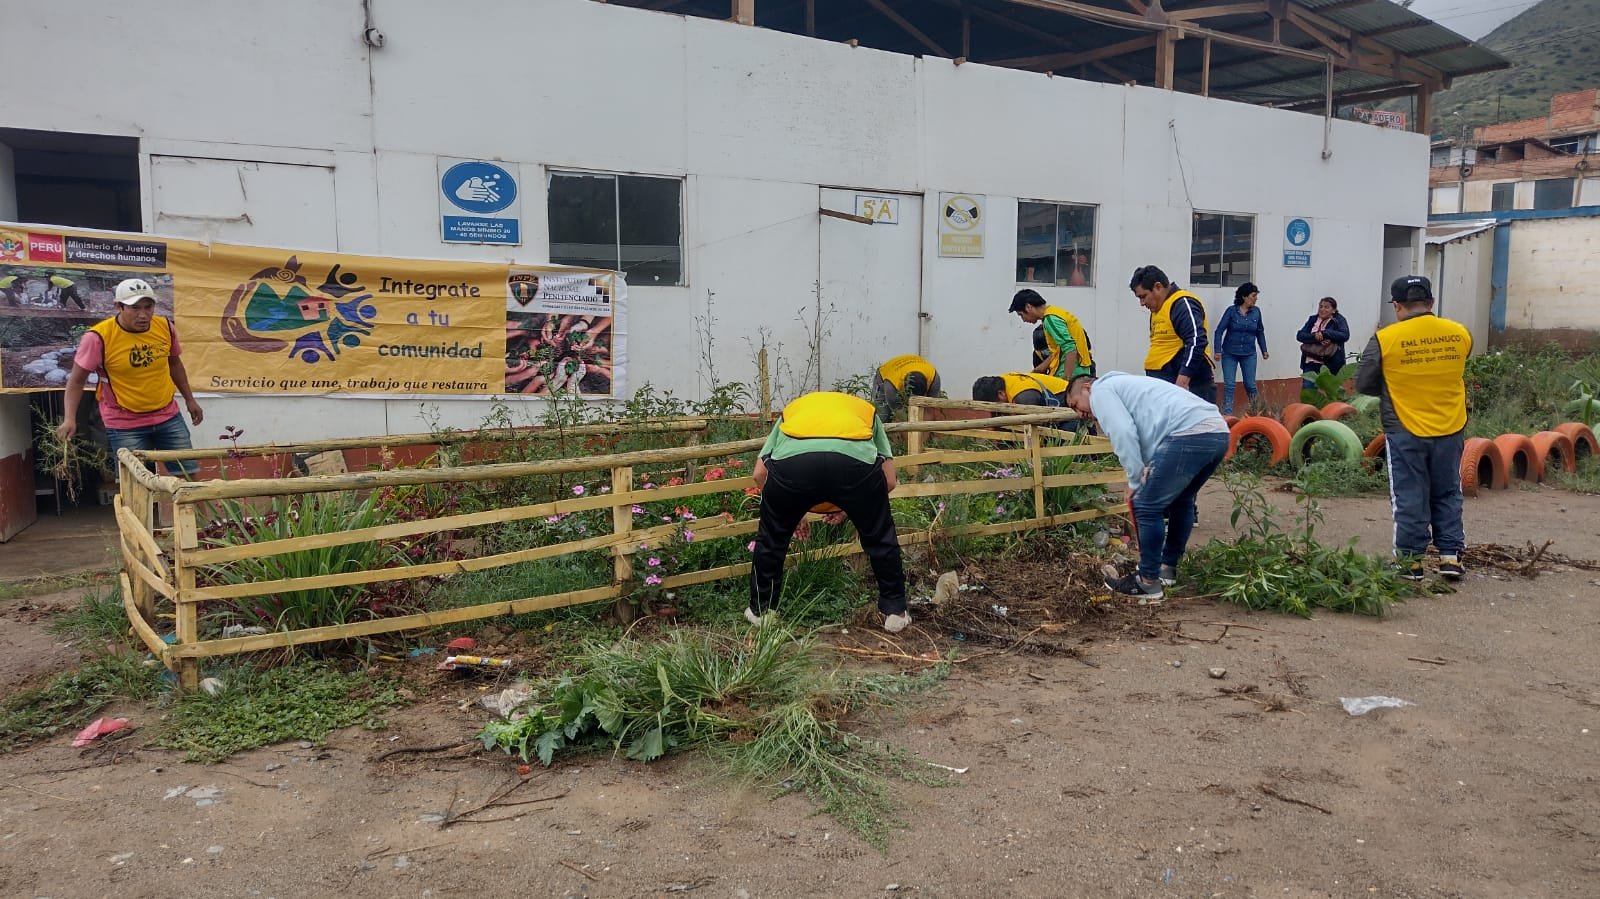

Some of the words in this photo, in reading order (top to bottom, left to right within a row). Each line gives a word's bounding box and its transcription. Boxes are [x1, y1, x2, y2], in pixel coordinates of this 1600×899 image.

[30, 241, 62, 254] PERÚ
[68, 240, 110, 251] Ministerio
[113, 243, 123, 251] de
[125, 244, 158, 254] Justicia
[68, 251, 73, 259] y
[76, 250, 116, 260] derechos
[117, 253, 156, 263] humanos
[378, 276, 481, 300] Integrate
[542, 292, 598, 303] PENITENCIARIO
[406, 312, 418, 325] a
[428, 310, 449, 327] tu
[1401, 340, 1418, 348] EML
[1421, 335, 1460, 345] HUANUCO
[378, 341, 482, 358] comunidad
[1405, 347, 1430, 356] Servicio
[1400, 355, 1423, 365] trabajo
[210, 375, 276, 389] Servicio
[279, 378, 307, 391] que
[311, 379, 342, 389] une,
[347, 378, 400, 391] trabajo
[403, 381, 428, 391] que
[432, 380, 488, 390] restaura
